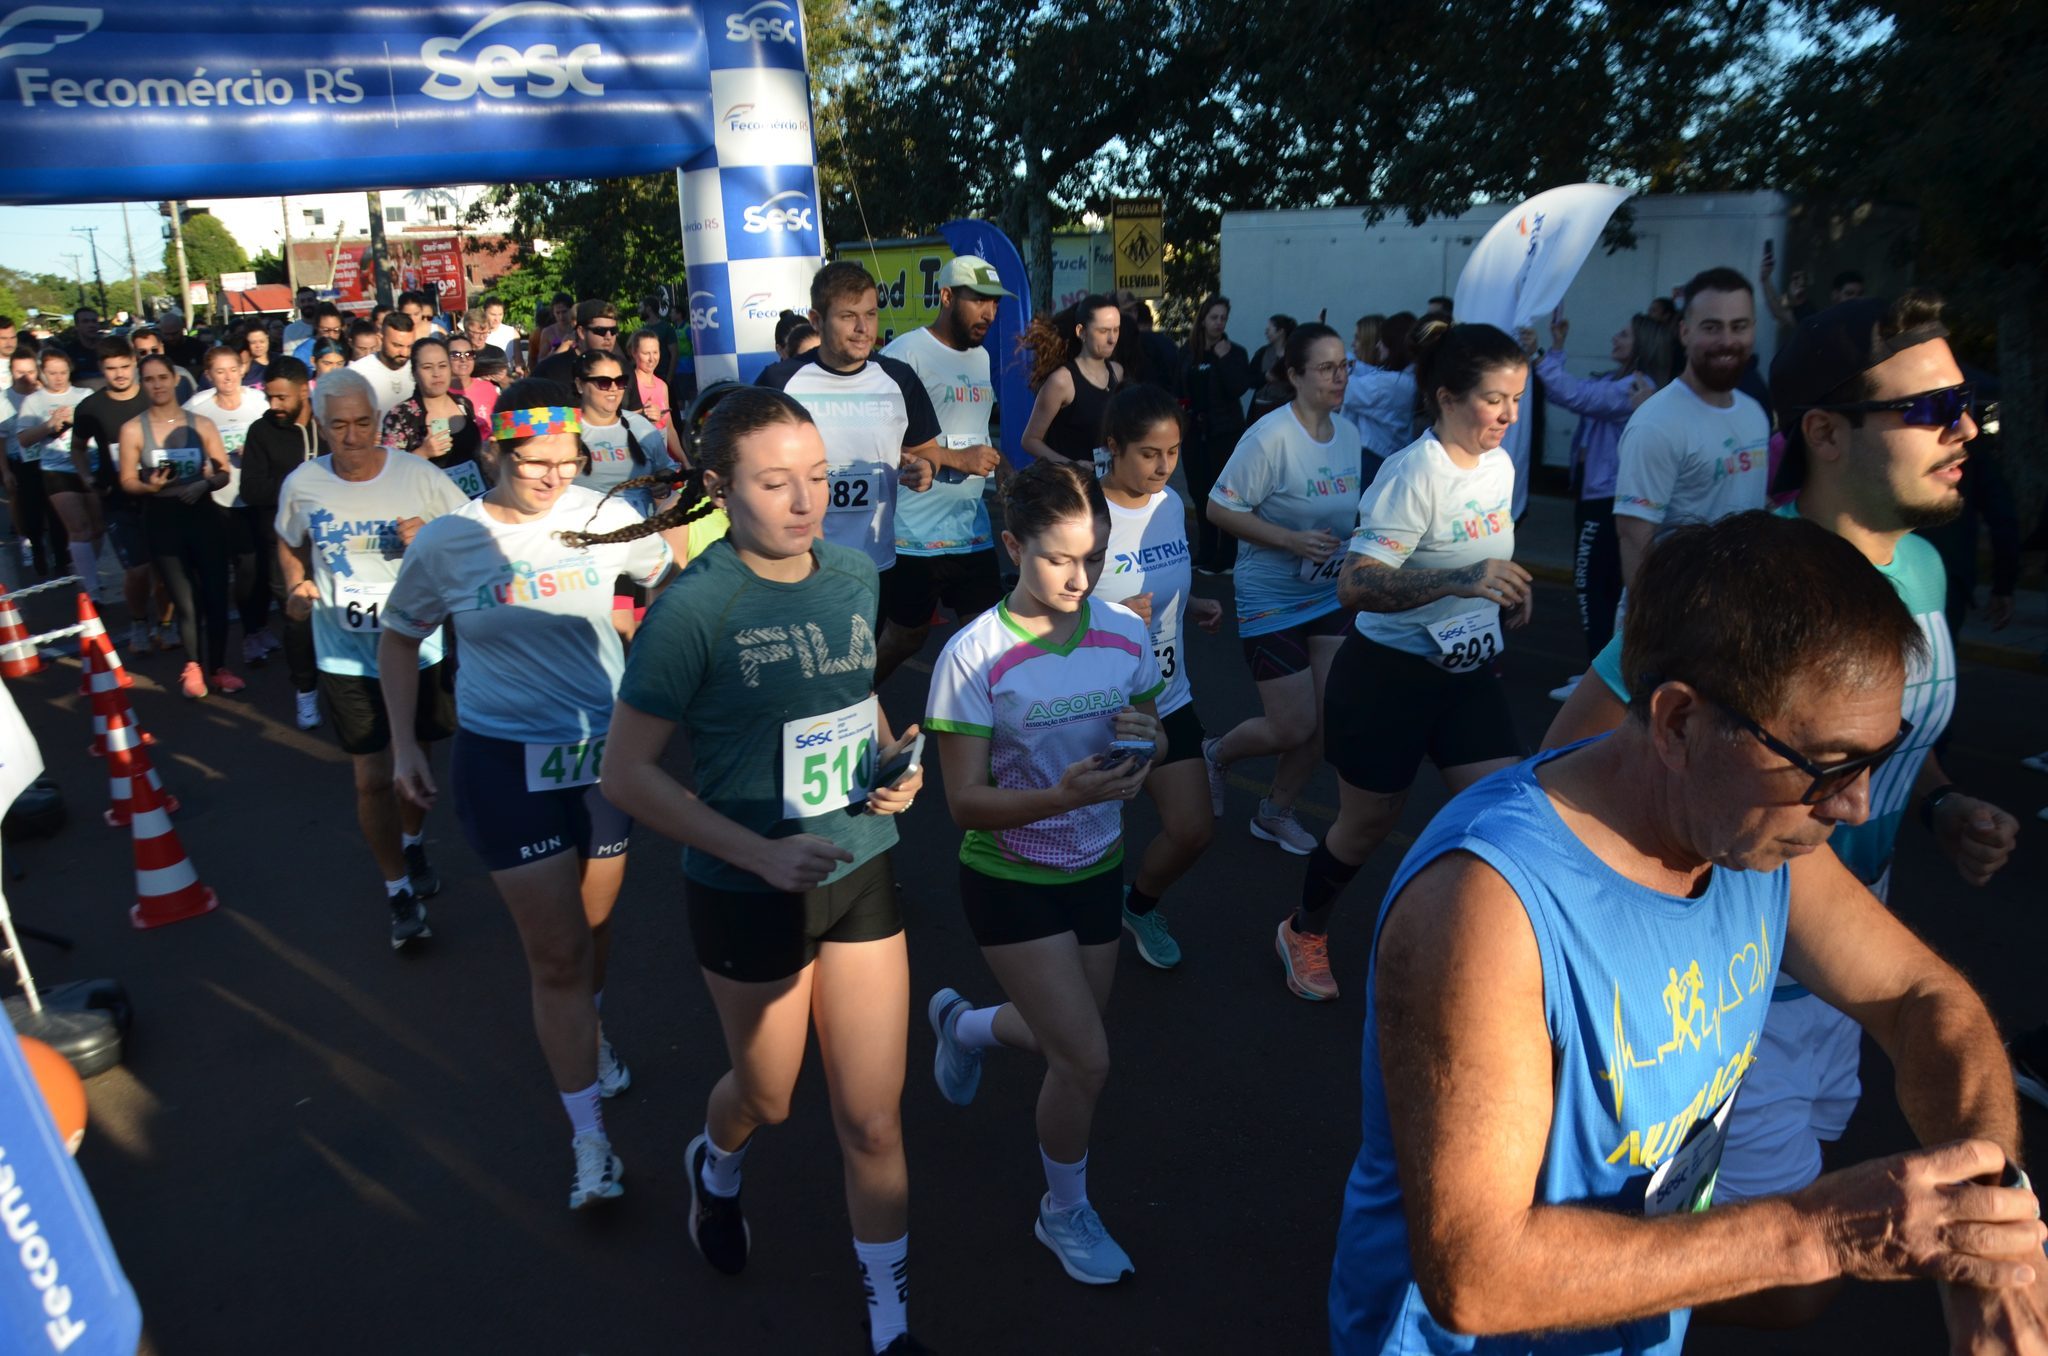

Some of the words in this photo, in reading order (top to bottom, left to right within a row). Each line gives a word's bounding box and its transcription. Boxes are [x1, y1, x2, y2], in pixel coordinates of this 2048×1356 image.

[725, 13, 797, 45] Sesc
[420, 36, 605, 101] Sesc
[15, 67, 294, 108] Fecomércio
[305, 67, 365, 104] RS
[704, 217, 719, 230] RS
[743, 205, 813, 234] Sesc
[1116, 203, 1159, 215] DEVAGAR
[1052, 250, 1087, 271] ruck
[1119, 274, 1160, 288] ELEVADA
[454, 473, 480, 494] 26
[828, 479, 869, 508] 82
[1130, 539, 1189, 566] VETRIA
[476, 566, 600, 610] Autismo
[733, 613, 878, 689] FILA
[1025, 687, 1124, 721] ACORA
[795, 729, 833, 750] Sesc
[801, 737, 872, 806] 510
[519, 834, 562, 860] RUN
